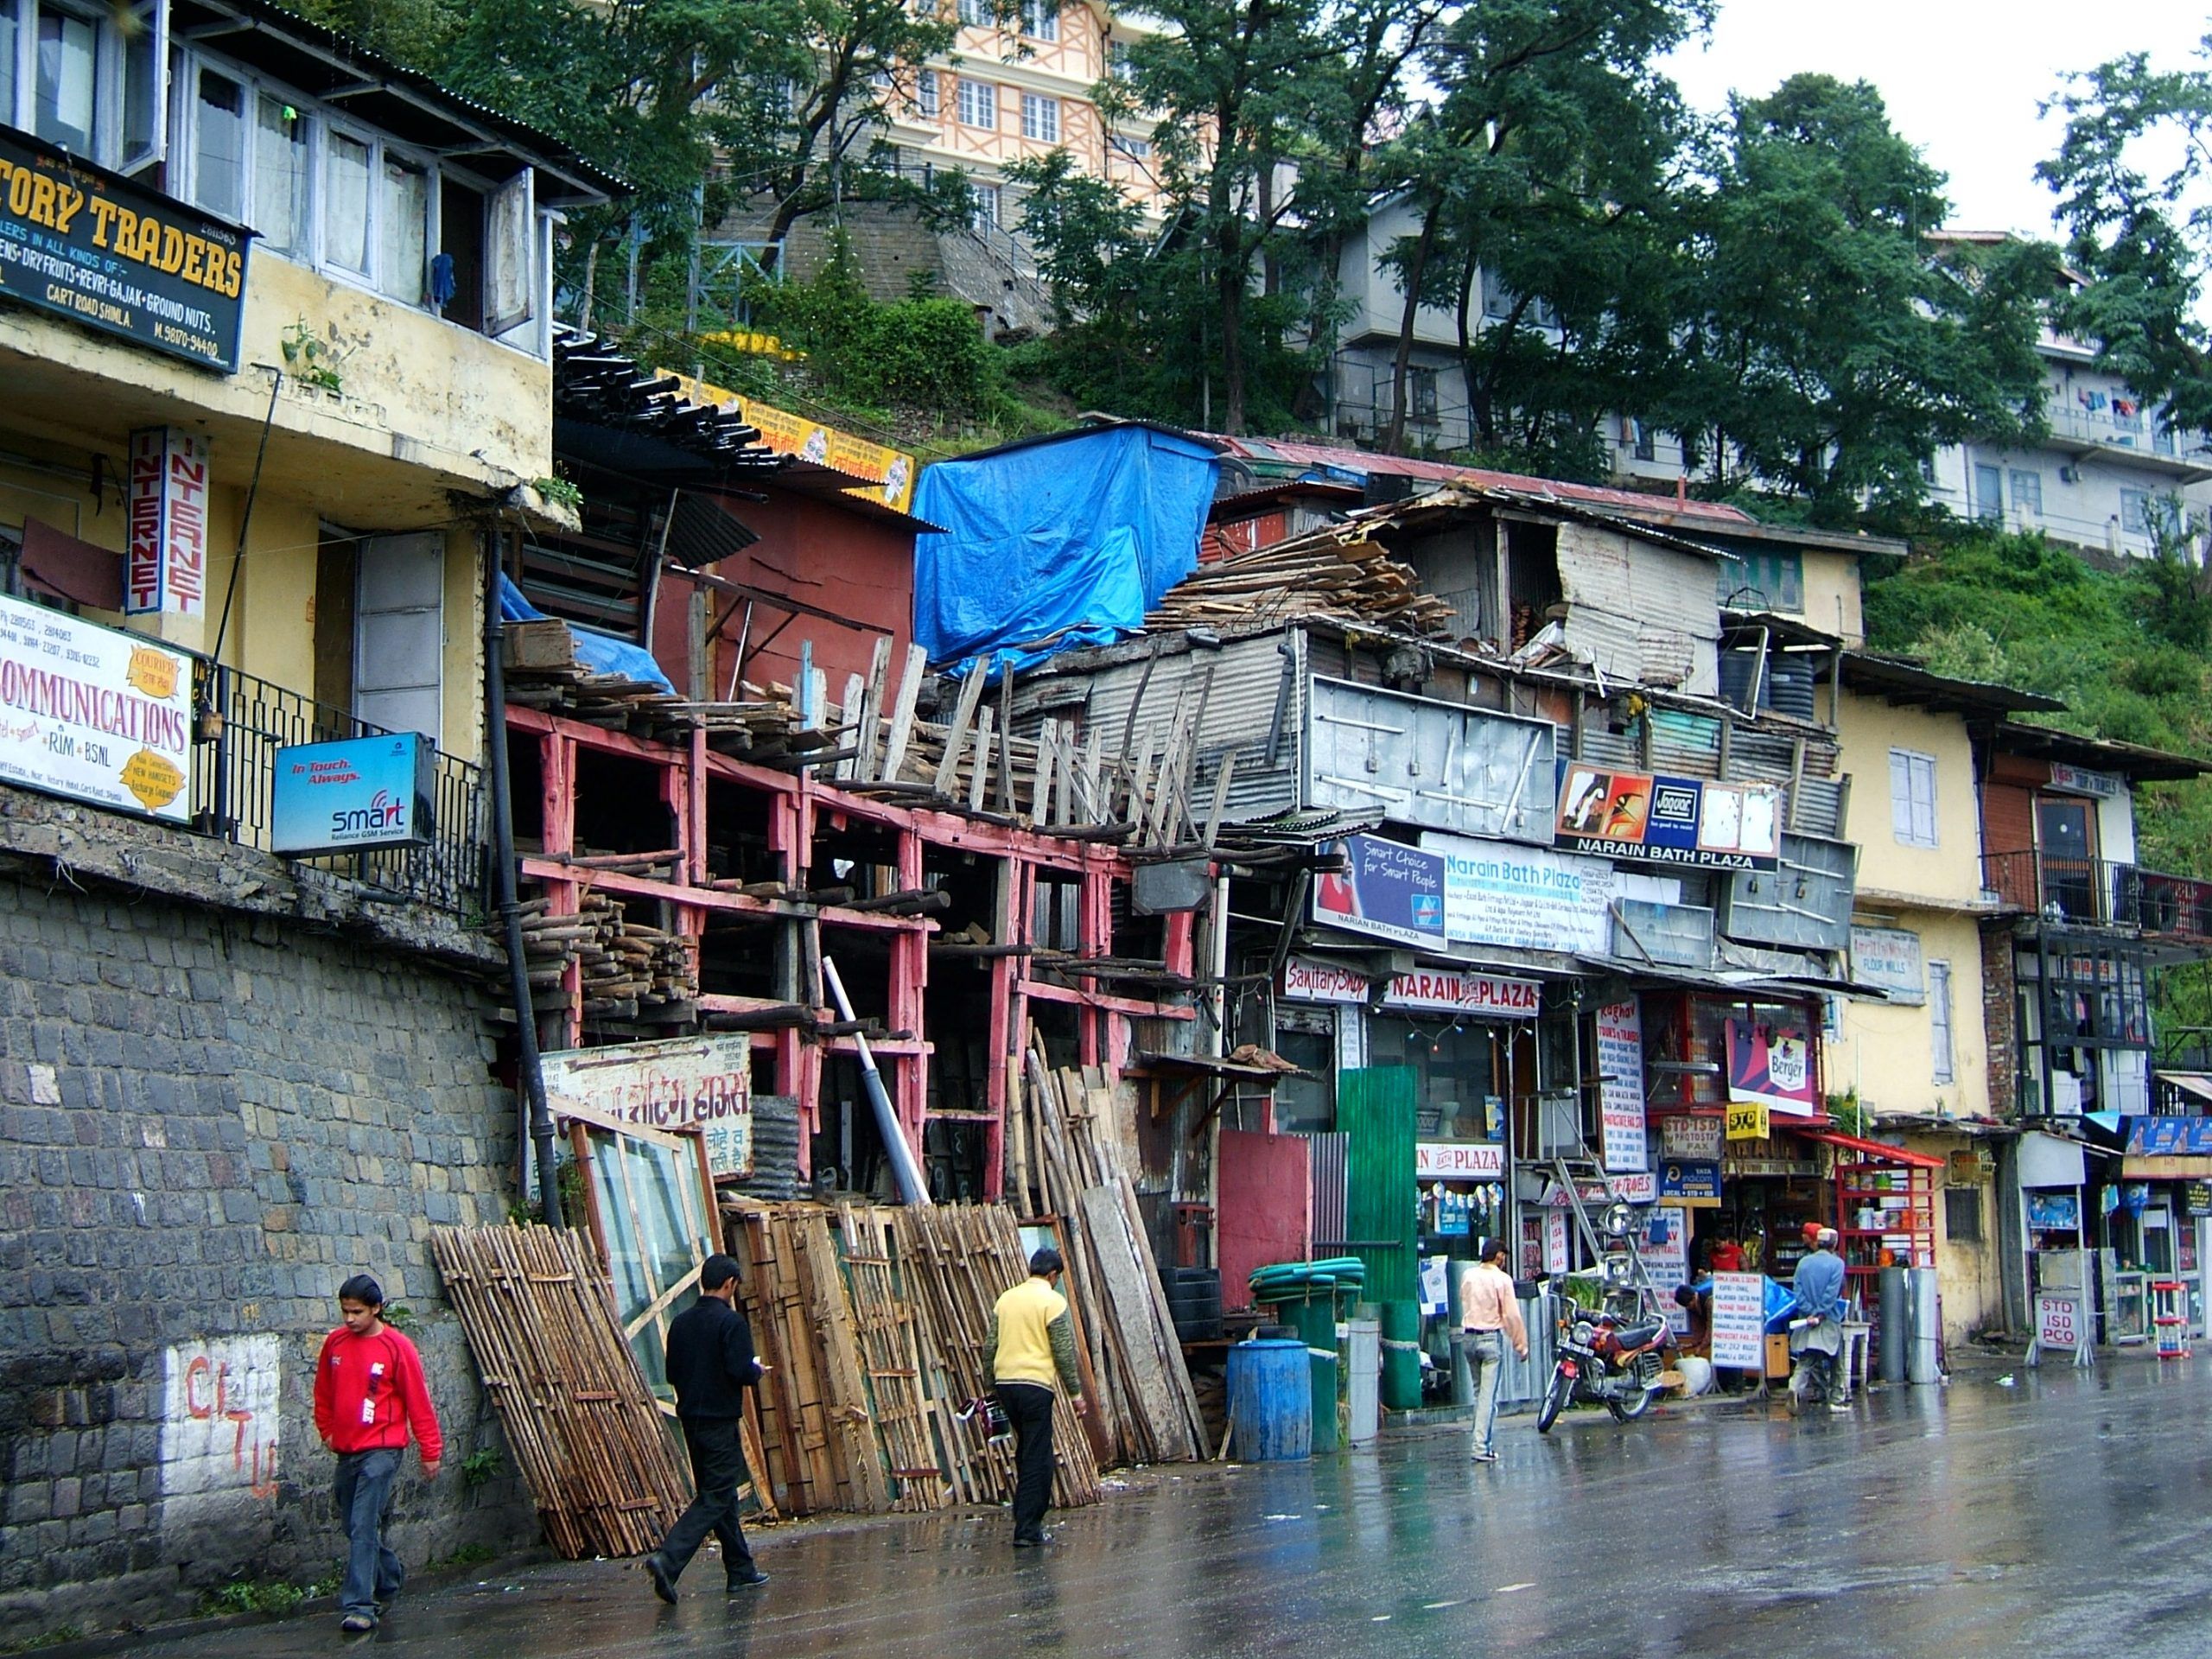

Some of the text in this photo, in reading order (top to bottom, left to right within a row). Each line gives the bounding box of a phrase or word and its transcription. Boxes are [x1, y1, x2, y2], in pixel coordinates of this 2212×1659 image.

[32, 232, 42, 247] IN
[46, 238, 66, 257] ALL
[69, 246, 100, 269] KINDS
[90, 195, 242, 298] TRADERS
[22, 247, 43, 271] DRY
[43, 256, 76, 283] FRUITS
[146, 293, 184, 322] GROUND
[47, 283, 73, 303] CART
[75, 291, 99, 311] ROAD
[131, 435, 162, 607] INTERNET
[168, 437, 204, 612] INTERNET
[0, 657, 185, 755] OMMUNICATIONS
[85, 741, 111, 767] BSNL
[292, 764, 305, 774] In
[332, 797, 405, 832] smart
[361, 830, 378, 838] GSM
[379, 828, 404, 837] Service
[1364, 842, 1429, 870] Smart Choice
[1577, 838, 1754, 869] NARAIN BATH PLAZA
[1363, 858, 1378, 876] for
[1381, 862, 1409, 881] Smart
[1412, 870, 1438, 893] People
[1446, 855, 1499, 878] Narain
[1502, 861, 1540, 884] Bath
[1543, 867, 1580, 890] Plaza
[1287, 963, 1366, 1000] Sanitary Shop
[1392, 974, 1460, 1001] NARAIN
[1479, 980, 1535, 1008] PLAZA
[1772, 1055, 1803, 1081] Berger
[1730, 1112, 1756, 1126] STD
[1454, 1150, 1500, 1170] PLAZA
[2042, 1299, 2072, 1313] STD
[2046, 1313, 2072, 1328] ISD
[2043, 1328, 2075, 1342] PCO
[185, 1356, 279, 1499] CITU
